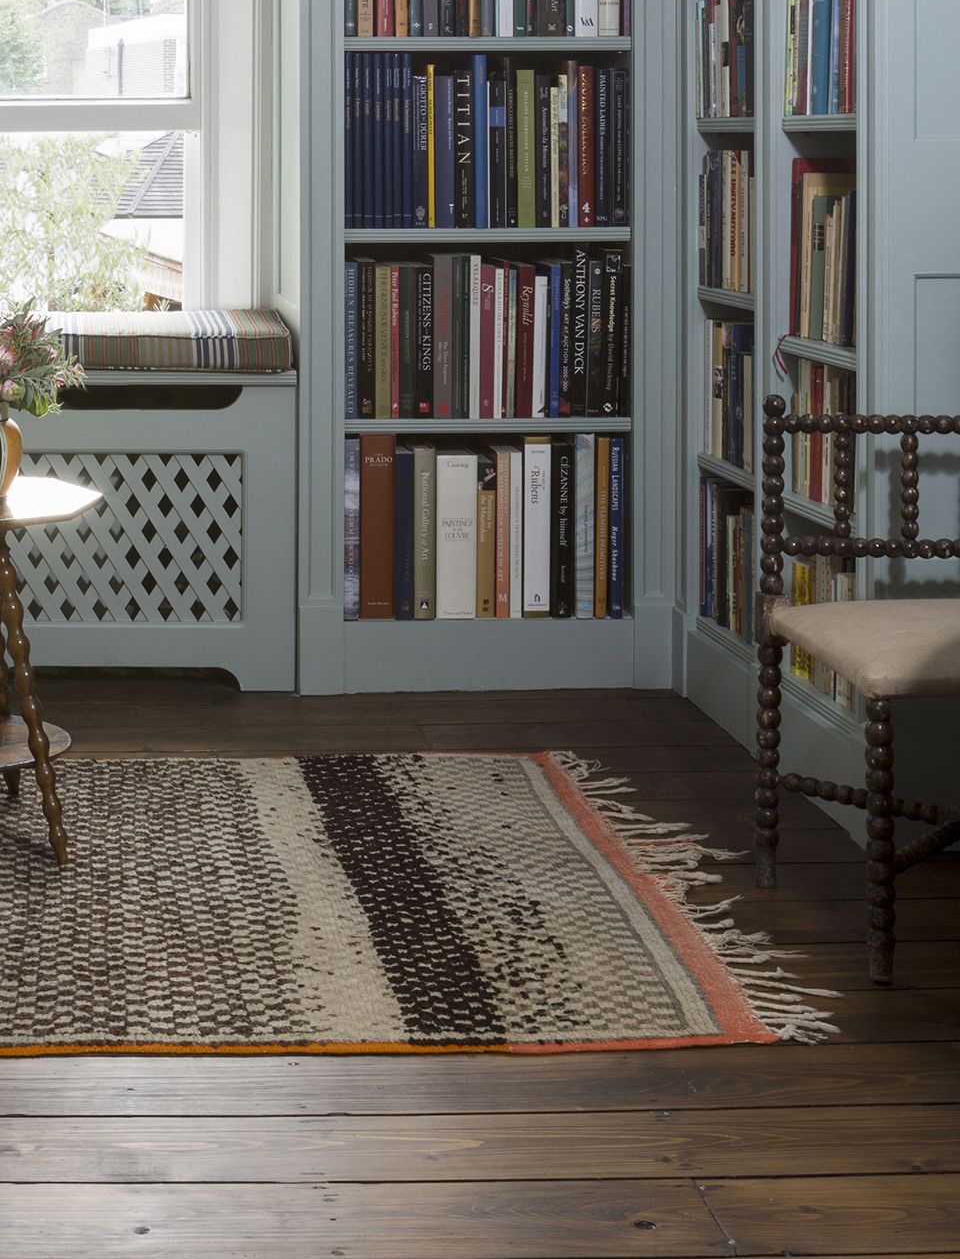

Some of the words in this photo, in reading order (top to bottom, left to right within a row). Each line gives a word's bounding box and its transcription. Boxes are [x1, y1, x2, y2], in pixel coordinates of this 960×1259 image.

[419, 83, 428, 116] GIOTTO
[456, 74, 471, 165] TITIAN
[419, 122, 428, 151] DÜRER
[542, 135, 548, 144] da
[580, 116, 590, 175] COLLECTION
[347, 268, 356, 306] HIDDEN
[380, 272, 388, 288] THE
[392, 271, 400, 288] Peter
[472, 262, 480, 306] VELÁZQUEZ
[562, 278, 572, 310] Sotheby's
[574, 249, 586, 310] ANTHONY
[609, 275, 617, 296] Secret
[380, 288, 388, 317] GENIUS
[392, 288, 400, 302] Paul
[422, 273, 432, 328] CITIZENS
[520, 285, 534, 327] Reynolds
[392, 302, 400, 327] Rubens
[496, 311, 503, 323] DA
[562, 312, 570, 325] ART
[591, 288, 602, 334] RUBENS
[606, 296, 616, 333] Knowledge
[347, 309, 356, 363] TREASURES
[562, 326, 570, 336] AT
[574, 313, 586, 339] VAN
[606, 333, 615, 342] by
[380, 328, 388, 356] VENICE
[422, 335, 432, 372] KINGS
[562, 335, 570, 364] AUCTION
[607, 342, 615, 362] David
[574, 341, 584, 375] DYCK
[347, 365, 356, 414] REVEALED
[605, 362, 614, 391] Hockney
[364, 456, 394, 464] PRADO
[611, 446, 620, 472] RUSSIAN
[421, 471, 430, 506] National
[531, 468, 542, 504] Rubens
[560, 456, 570, 504] CÉZANNE
[611, 474, 620, 511] LANDSCAPES
[420, 508, 430, 538] Gallery
[442, 519, 474, 527] PAINTINGS
[558, 506, 568, 515] by
[444, 532, 470, 540] LOUVRE
[559, 517, 568, 547] himself
[421, 548, 430, 561] Art
[498, 559, 504, 567] OF
